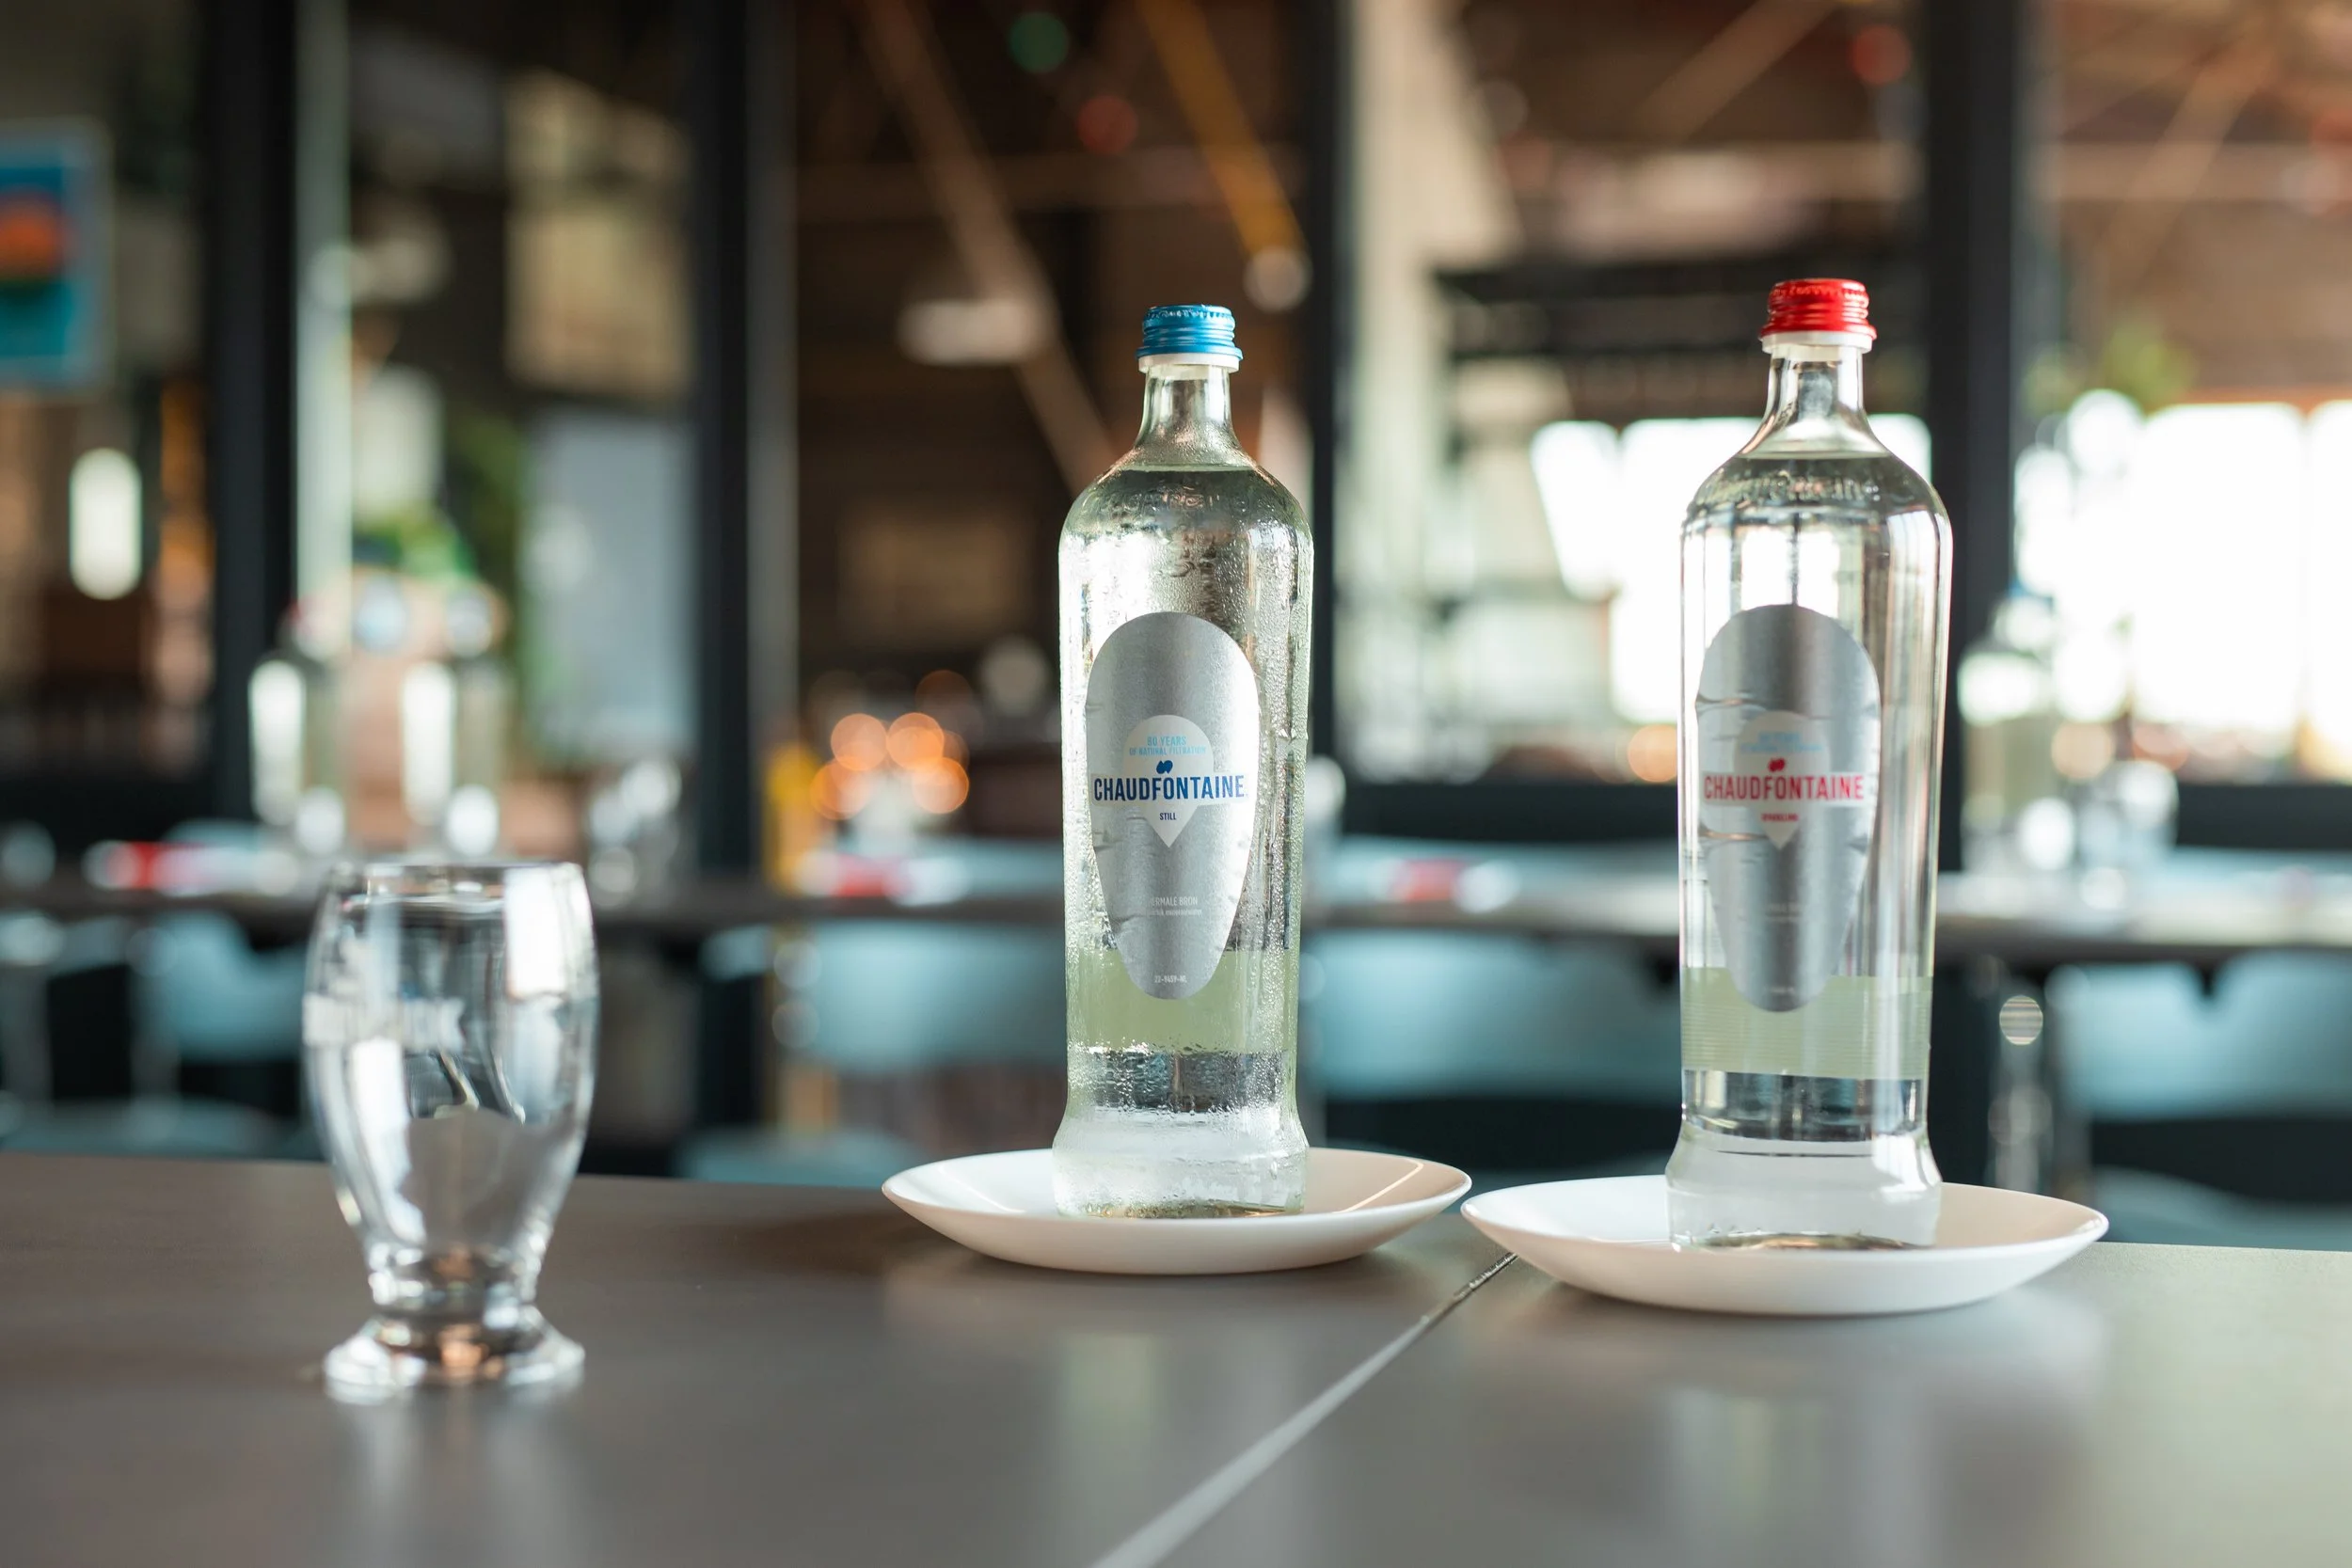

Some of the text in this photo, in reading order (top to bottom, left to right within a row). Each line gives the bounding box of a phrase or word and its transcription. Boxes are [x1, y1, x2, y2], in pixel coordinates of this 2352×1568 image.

[1160, 736, 1187, 746] YEARS
[1138, 747, 1168, 756] NATURAL
[1169, 746, 1207, 755] FILTRATION
[1093, 774, 1245, 801] CHAUDFONTAINE
[1704, 775, 1865, 800] CHAUDFONTAINE
[1159, 812, 1177, 821] STILL
[1179, 895, 1199, 906] BRON
